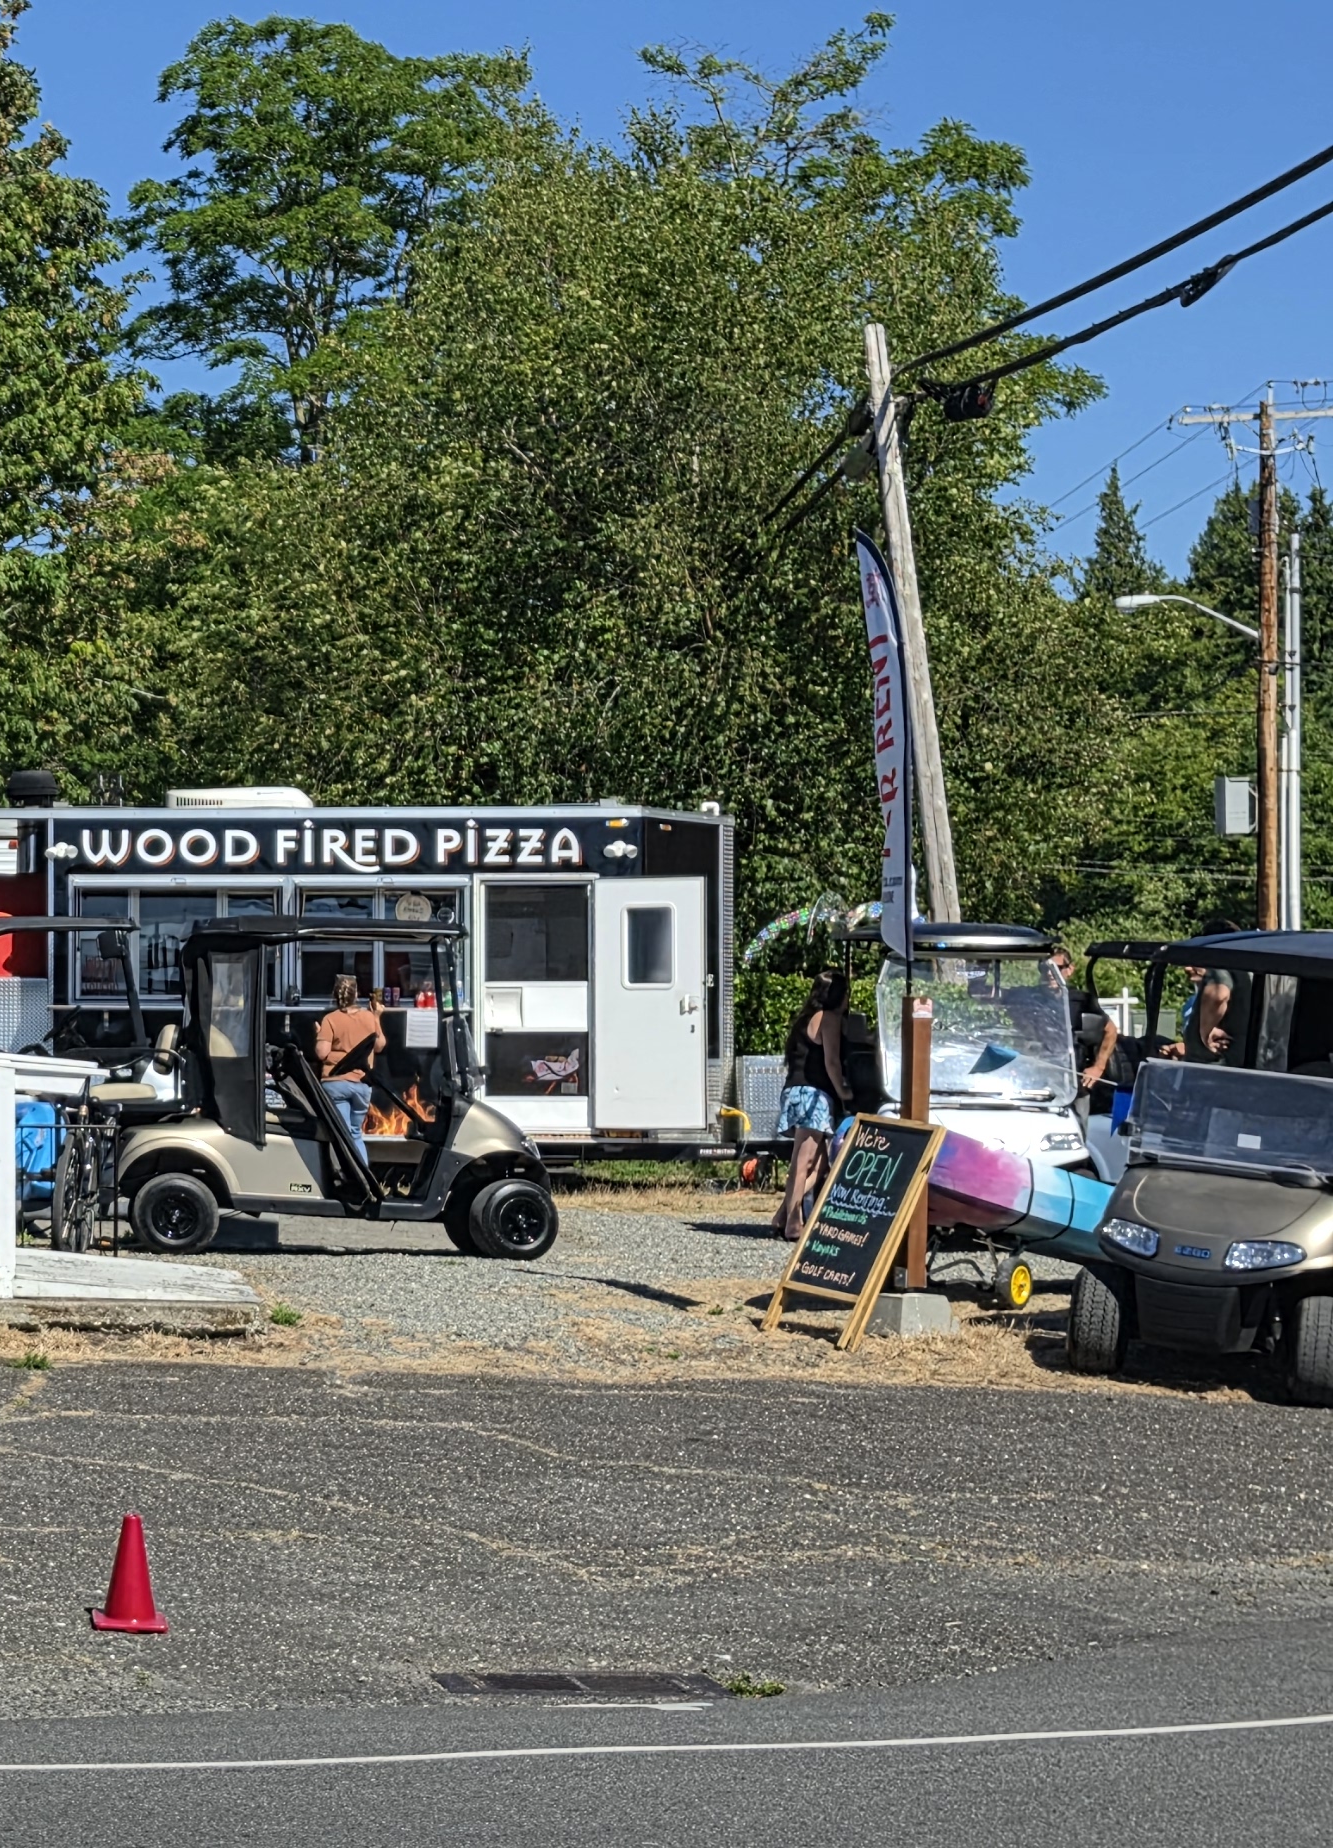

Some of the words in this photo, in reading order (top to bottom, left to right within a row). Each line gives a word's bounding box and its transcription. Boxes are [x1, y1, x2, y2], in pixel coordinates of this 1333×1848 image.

[81, 828, 261, 867] WOOD
[855, 1125, 891, 1151] We're
[845, 1150, 903, 1191] OPEN
[818, 1222, 839, 1239] YARD
[801, 1261, 824, 1277] GOLF
[823, 1270, 856, 1287] CARTS!
